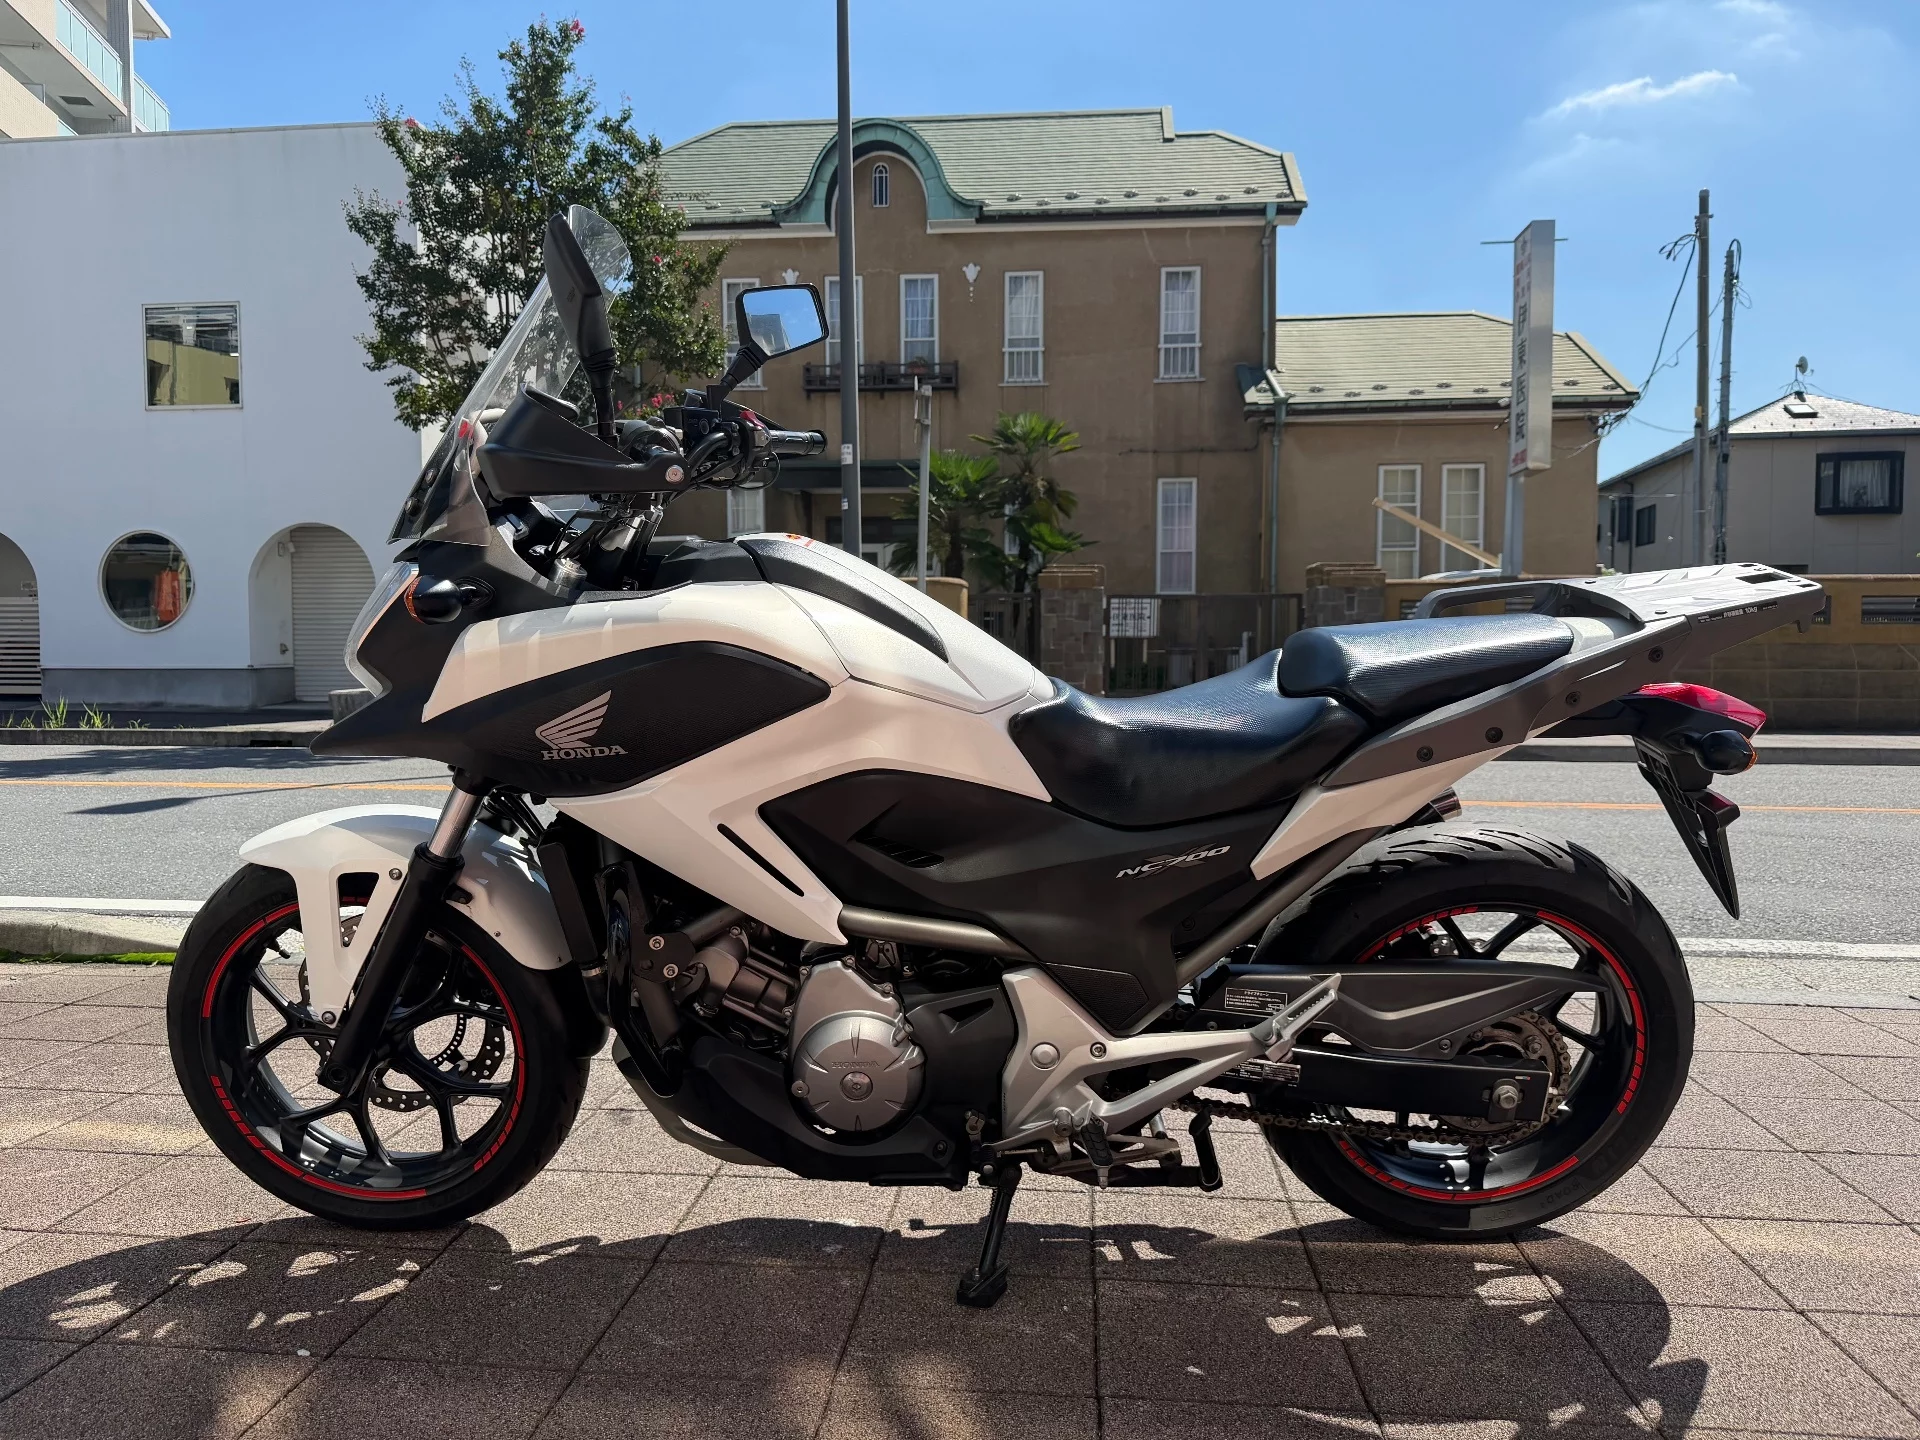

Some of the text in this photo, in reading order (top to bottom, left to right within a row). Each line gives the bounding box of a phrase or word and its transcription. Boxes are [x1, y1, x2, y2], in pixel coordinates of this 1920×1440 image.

[540, 745, 629, 761] HONDA
[1115, 845, 1231, 879] NC700
[831, 1060, 880, 1069] HONDA
